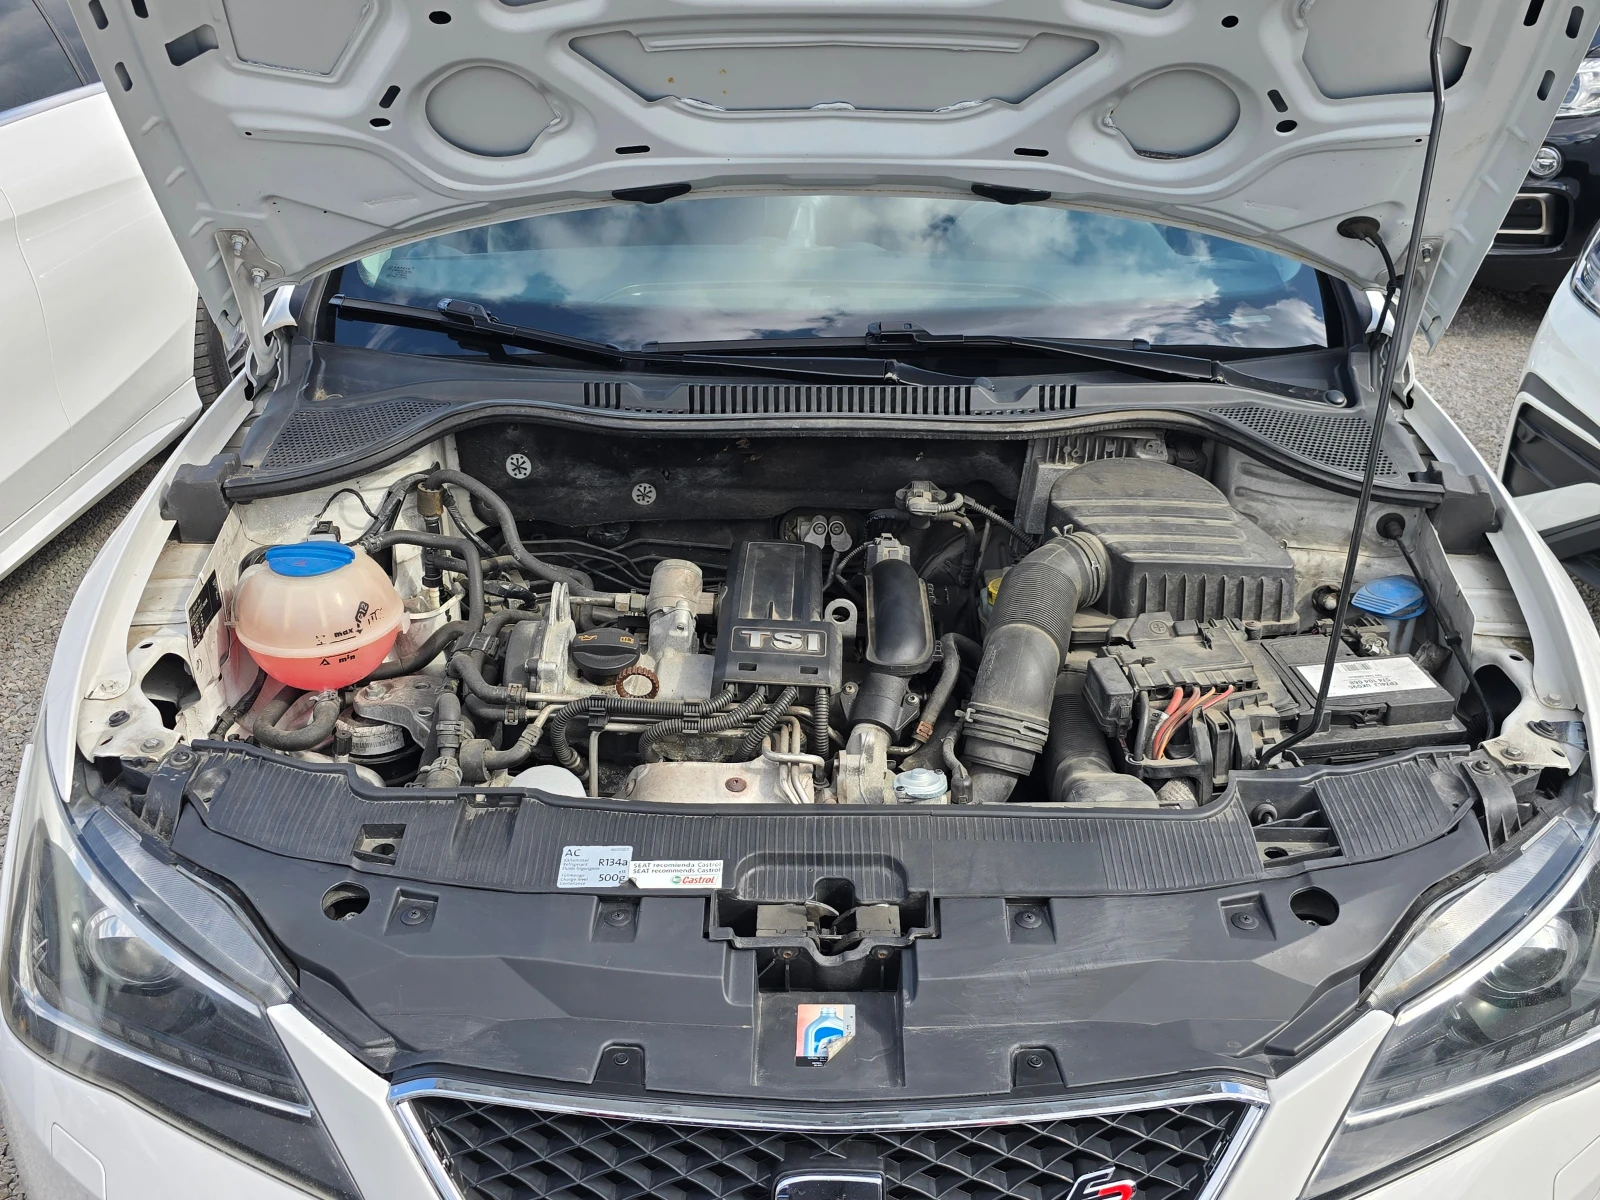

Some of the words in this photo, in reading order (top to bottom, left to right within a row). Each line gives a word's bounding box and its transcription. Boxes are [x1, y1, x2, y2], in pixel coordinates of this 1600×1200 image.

[334, 628, 354, 638] max
[740, 630, 820, 652] TSI
[338, 654, 356, 664] min
[565, 849, 581, 857] AC
[598, 858, 628, 867] R134a
[598, 873, 626, 884] 500g
[682, 876, 715, 884] Castrol
